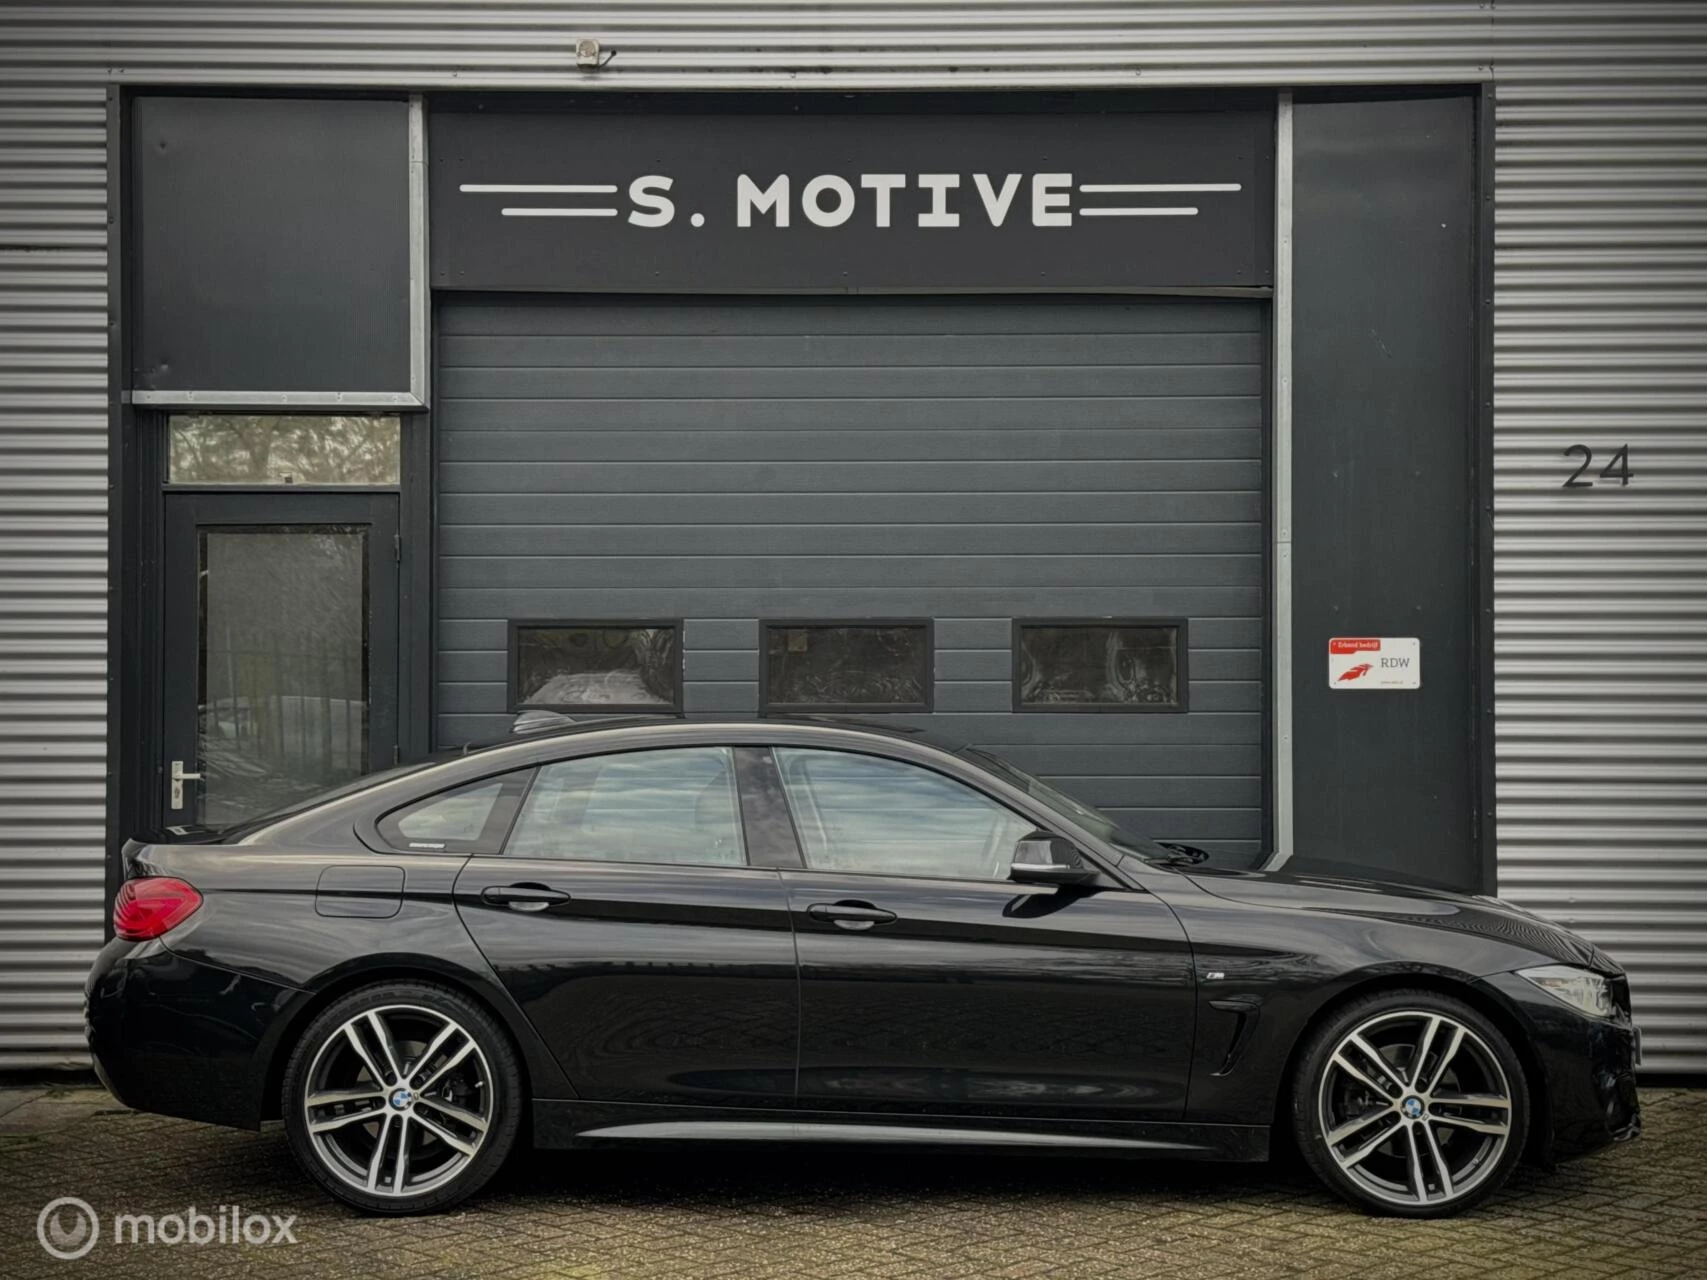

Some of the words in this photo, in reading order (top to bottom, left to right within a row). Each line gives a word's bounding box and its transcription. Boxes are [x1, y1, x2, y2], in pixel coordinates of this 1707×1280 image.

[628, 174, 705, 228] S.
[737, 173, 1073, 228] MOTIVE
[1562, 443, 1634, 488] 24
[1381, 657, 1410, 669] RDW
